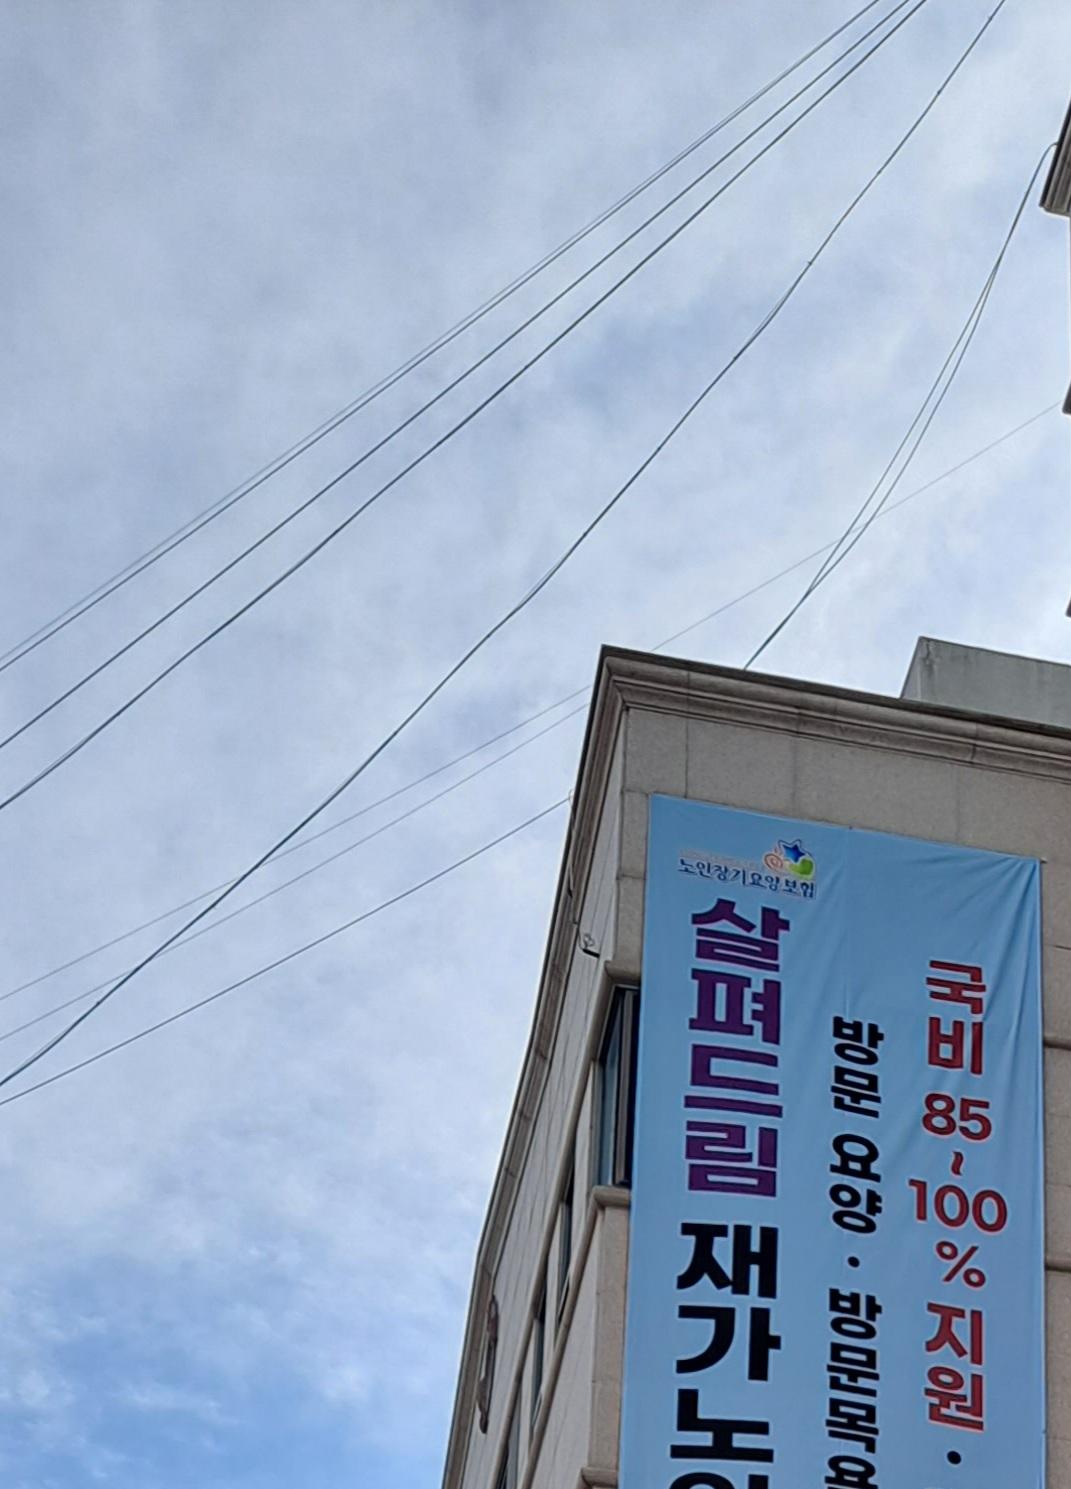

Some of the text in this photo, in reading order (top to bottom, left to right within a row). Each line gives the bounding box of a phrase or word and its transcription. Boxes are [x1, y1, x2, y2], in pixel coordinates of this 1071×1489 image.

[684, 898, 791, 1198] 살펴드림
[925, 960, 987, 1075] 국비
[924, 1302, 985, 1432] 지원
